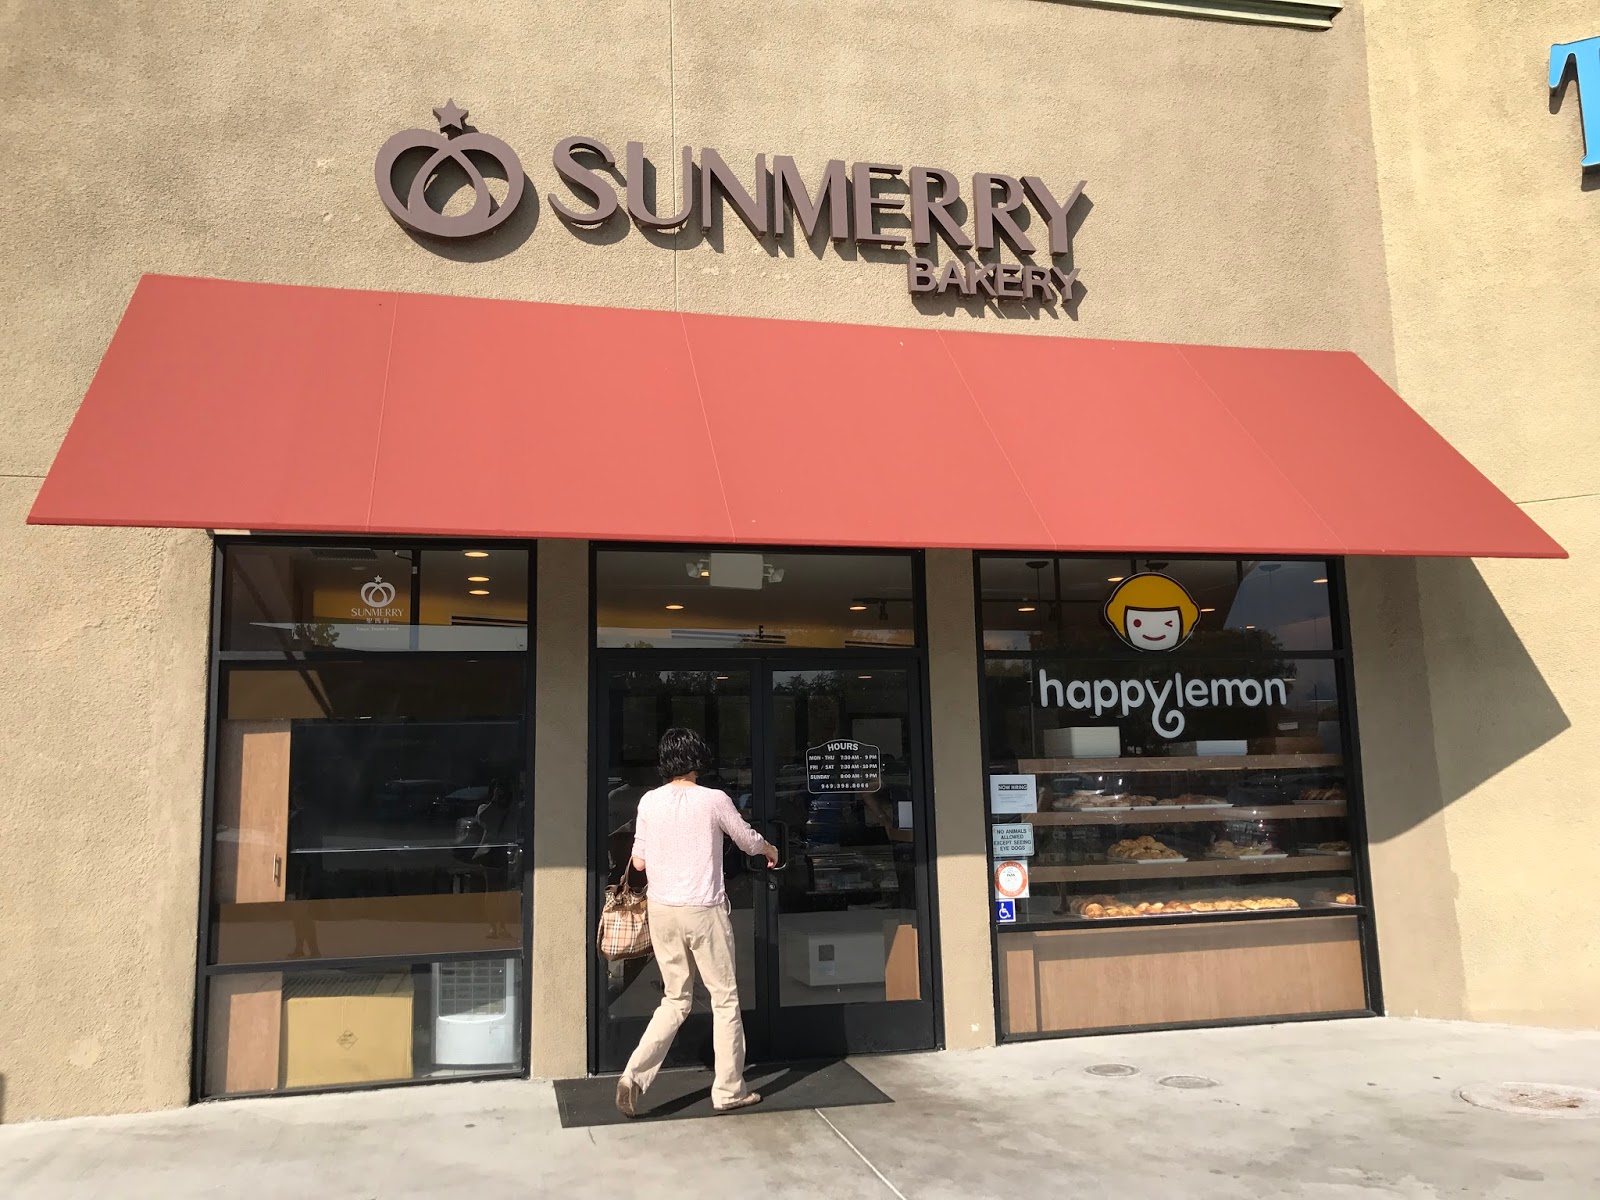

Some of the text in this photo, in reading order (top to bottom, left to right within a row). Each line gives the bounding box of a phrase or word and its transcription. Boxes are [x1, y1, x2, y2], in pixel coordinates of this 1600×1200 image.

[547, 135, 1088, 257] SUNMERRY
[907, 257, 1081, 304] BAKERY
[351, 607, 404, 617] SUNMERRY
[826, 742, 859, 752] HOURS
